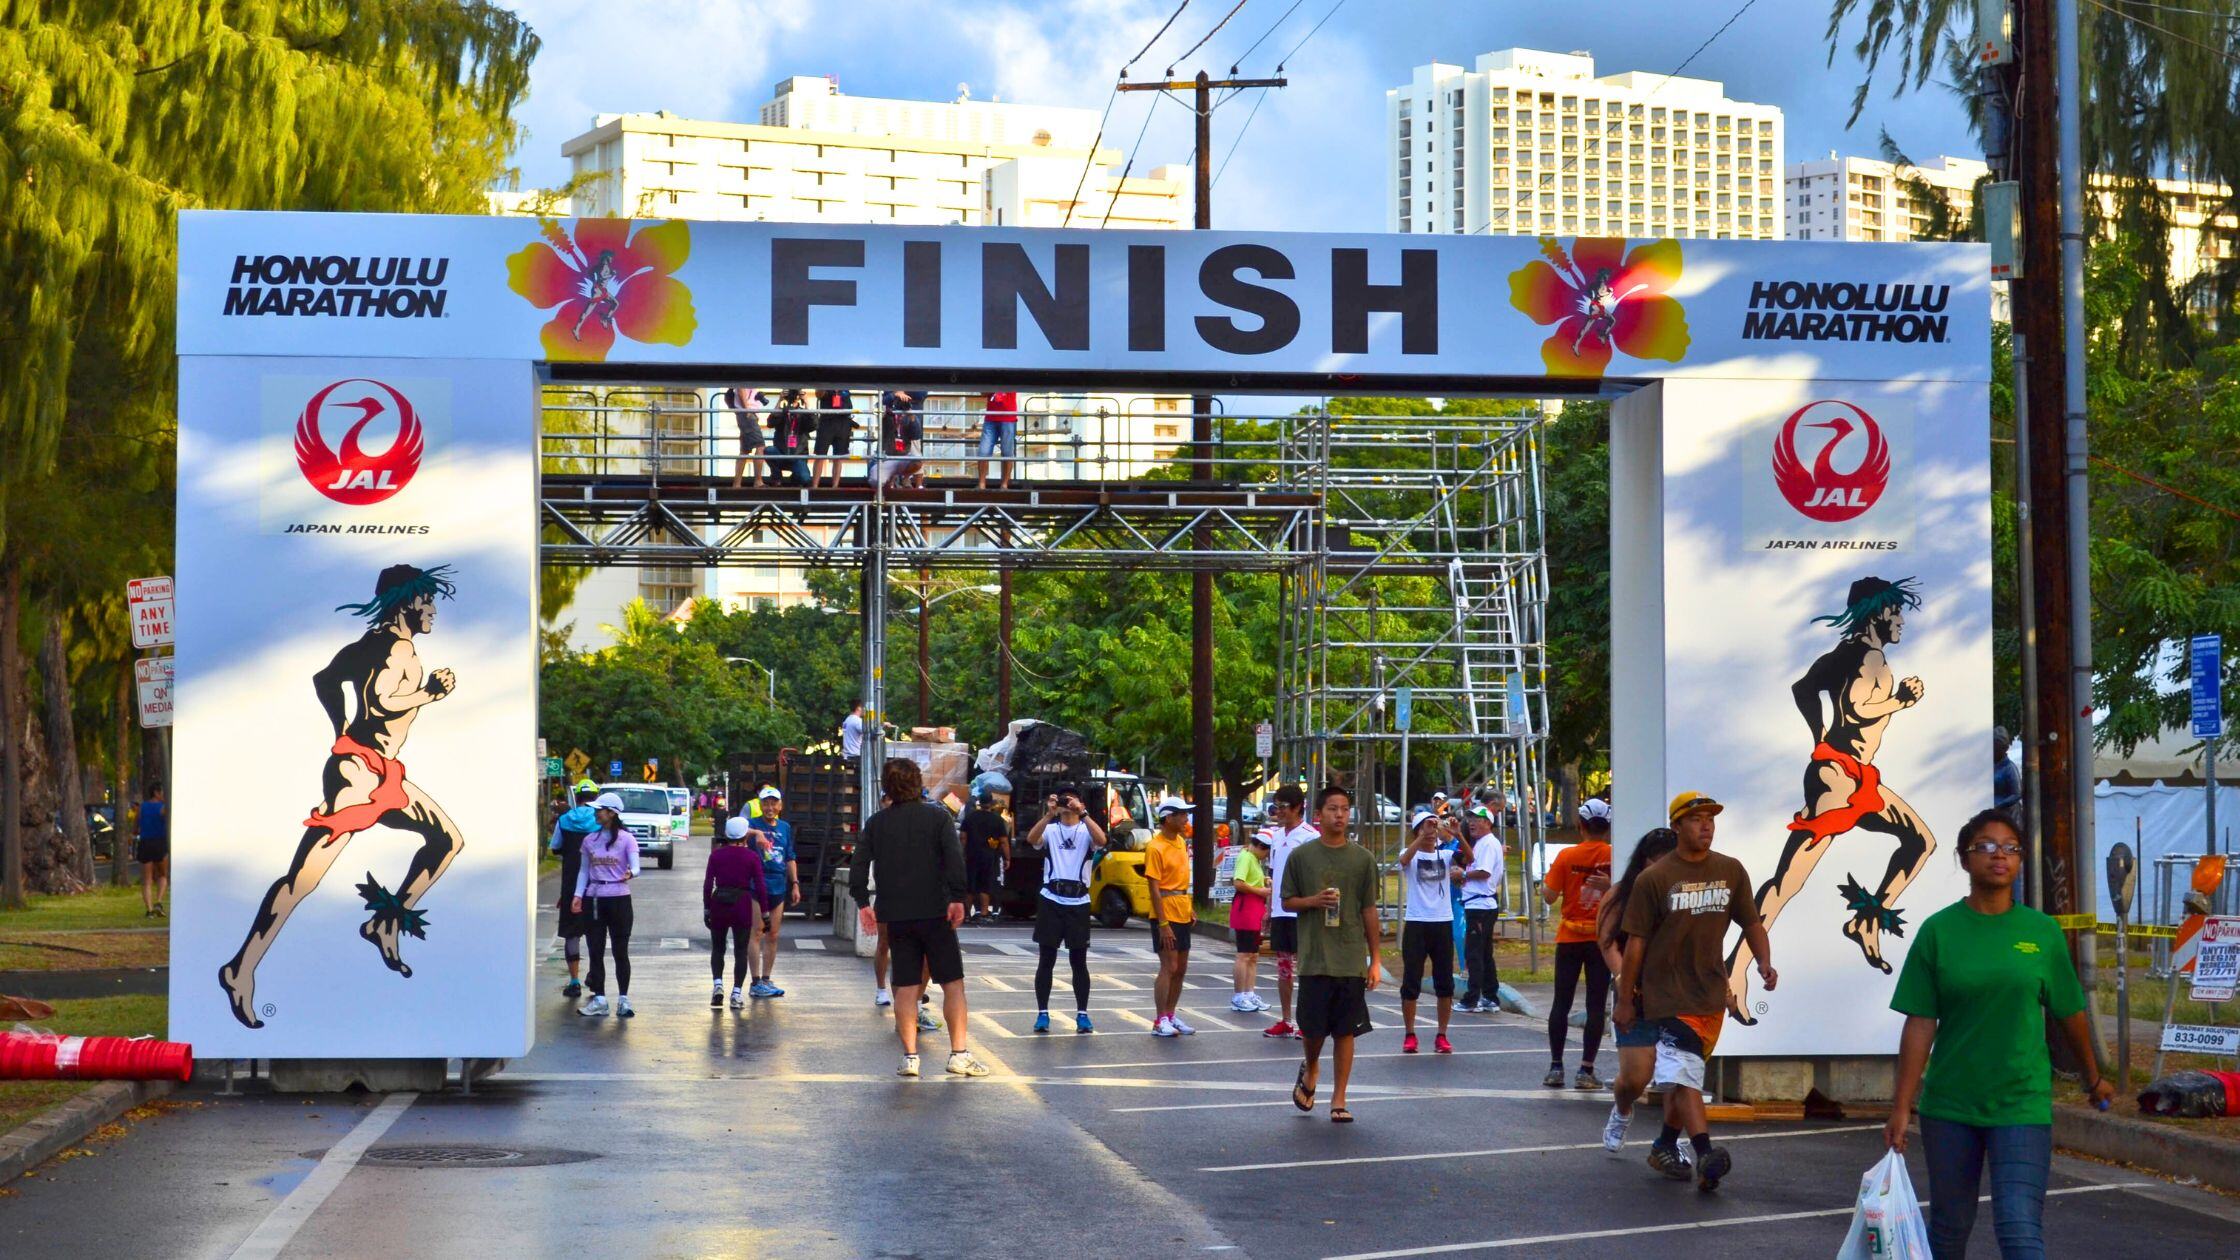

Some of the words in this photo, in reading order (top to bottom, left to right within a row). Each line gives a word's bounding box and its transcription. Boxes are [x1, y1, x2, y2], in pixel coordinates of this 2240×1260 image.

[230, 255, 449, 286] HONOLULU
[223, 287, 447, 318] MARATHON
[771, 237, 1438, 355] FINISH
[1749, 281, 1950, 313] HONOLULU
[1742, 312, 1949, 343] MARATHON
[327, 469, 398, 490] JAL
[1804, 487, 1867, 507] JAL
[284, 524, 342, 534] JAPAN
[346, 524, 430, 535] AIRLINES
[1765, 540, 1818, 550] JAPAN
[1821, 541, 1898, 550] AIRLINES
[130, 585, 143, 599] NO
[143, 584, 170, 594] PARKING
[141, 606, 165, 620] ANY
[139, 621, 170, 637] TIME
[138, 665, 149, 678] NO
[144, 701, 173, 714] MEDIA
[1671, 888, 1731, 911] TROJANS
[2202, 923, 2217, 939] NO
[2218, 926, 2240, 937] PARKIN
[2202, 954, 2237, 962] BEGIN
[2174, 1032, 2225, 1045] 833-0099
